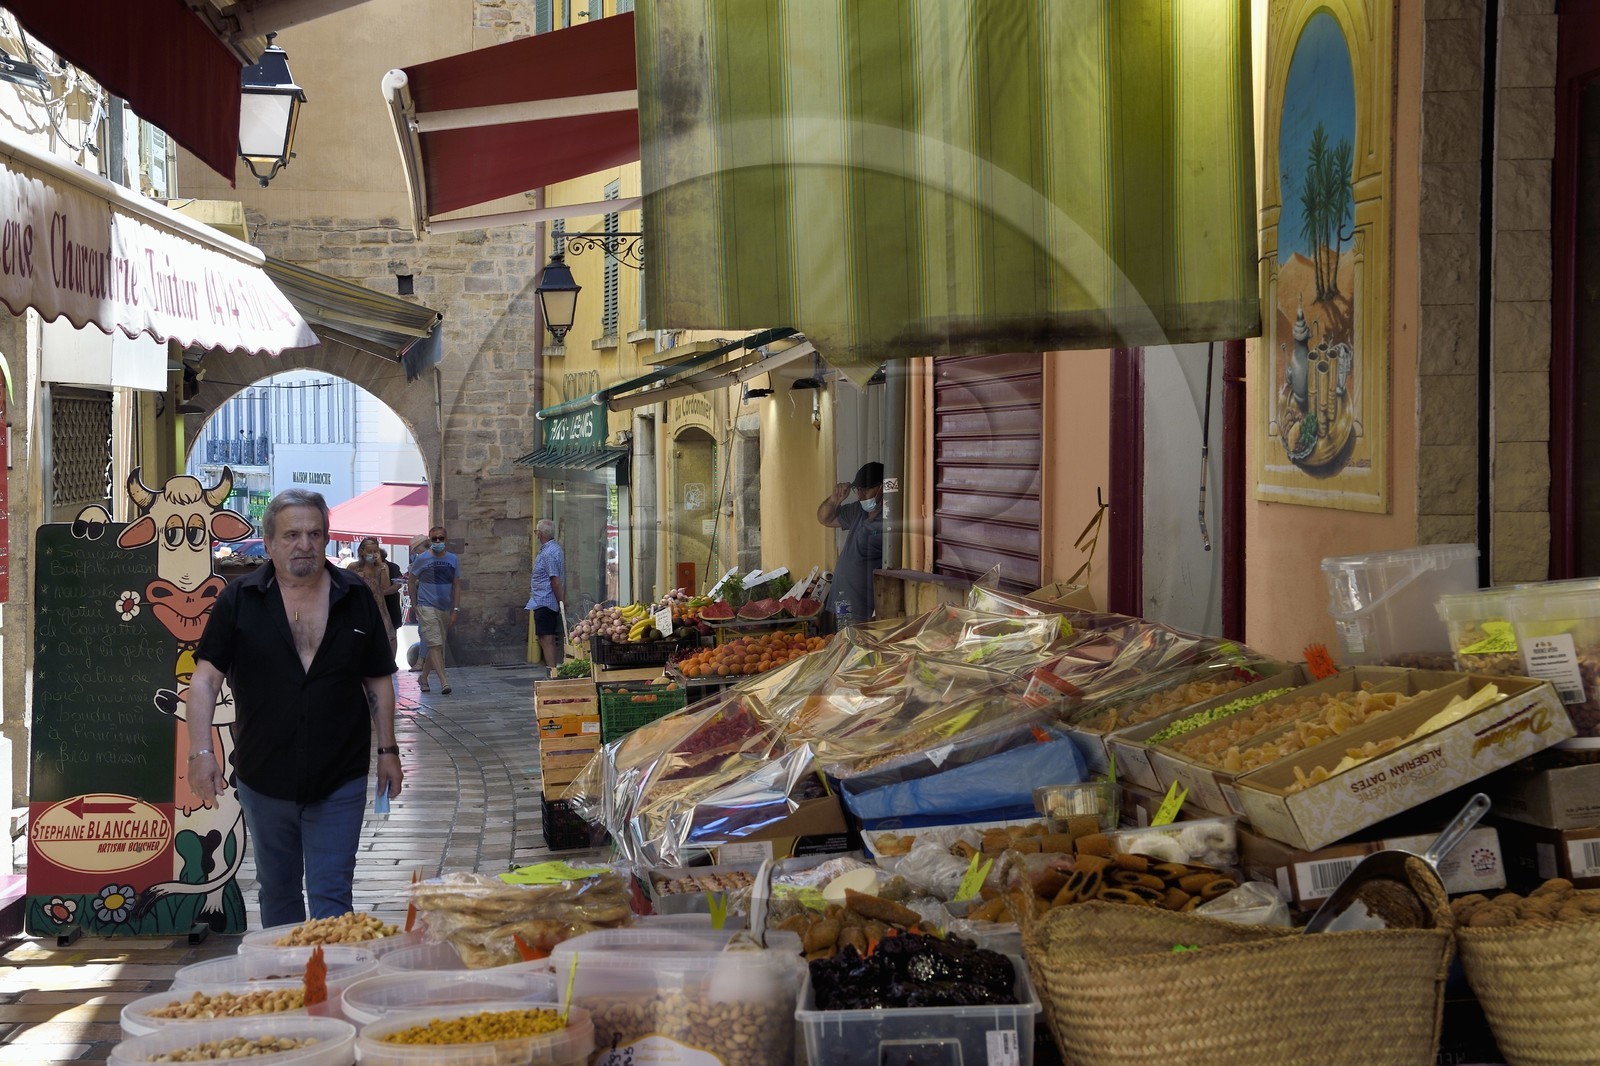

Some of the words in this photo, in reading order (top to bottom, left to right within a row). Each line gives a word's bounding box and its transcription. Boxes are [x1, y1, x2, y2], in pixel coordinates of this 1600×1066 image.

[1389, 746, 1443, 777] ALGERIAN
[1410, 757, 1449, 782] DATTES
[1349, 773, 1388, 794] DATES
[87, 820, 168, 838] BLANCHARD
[97, 842, 126, 853] ARTISAN
[128, 841, 160, 852] BOUCHER
